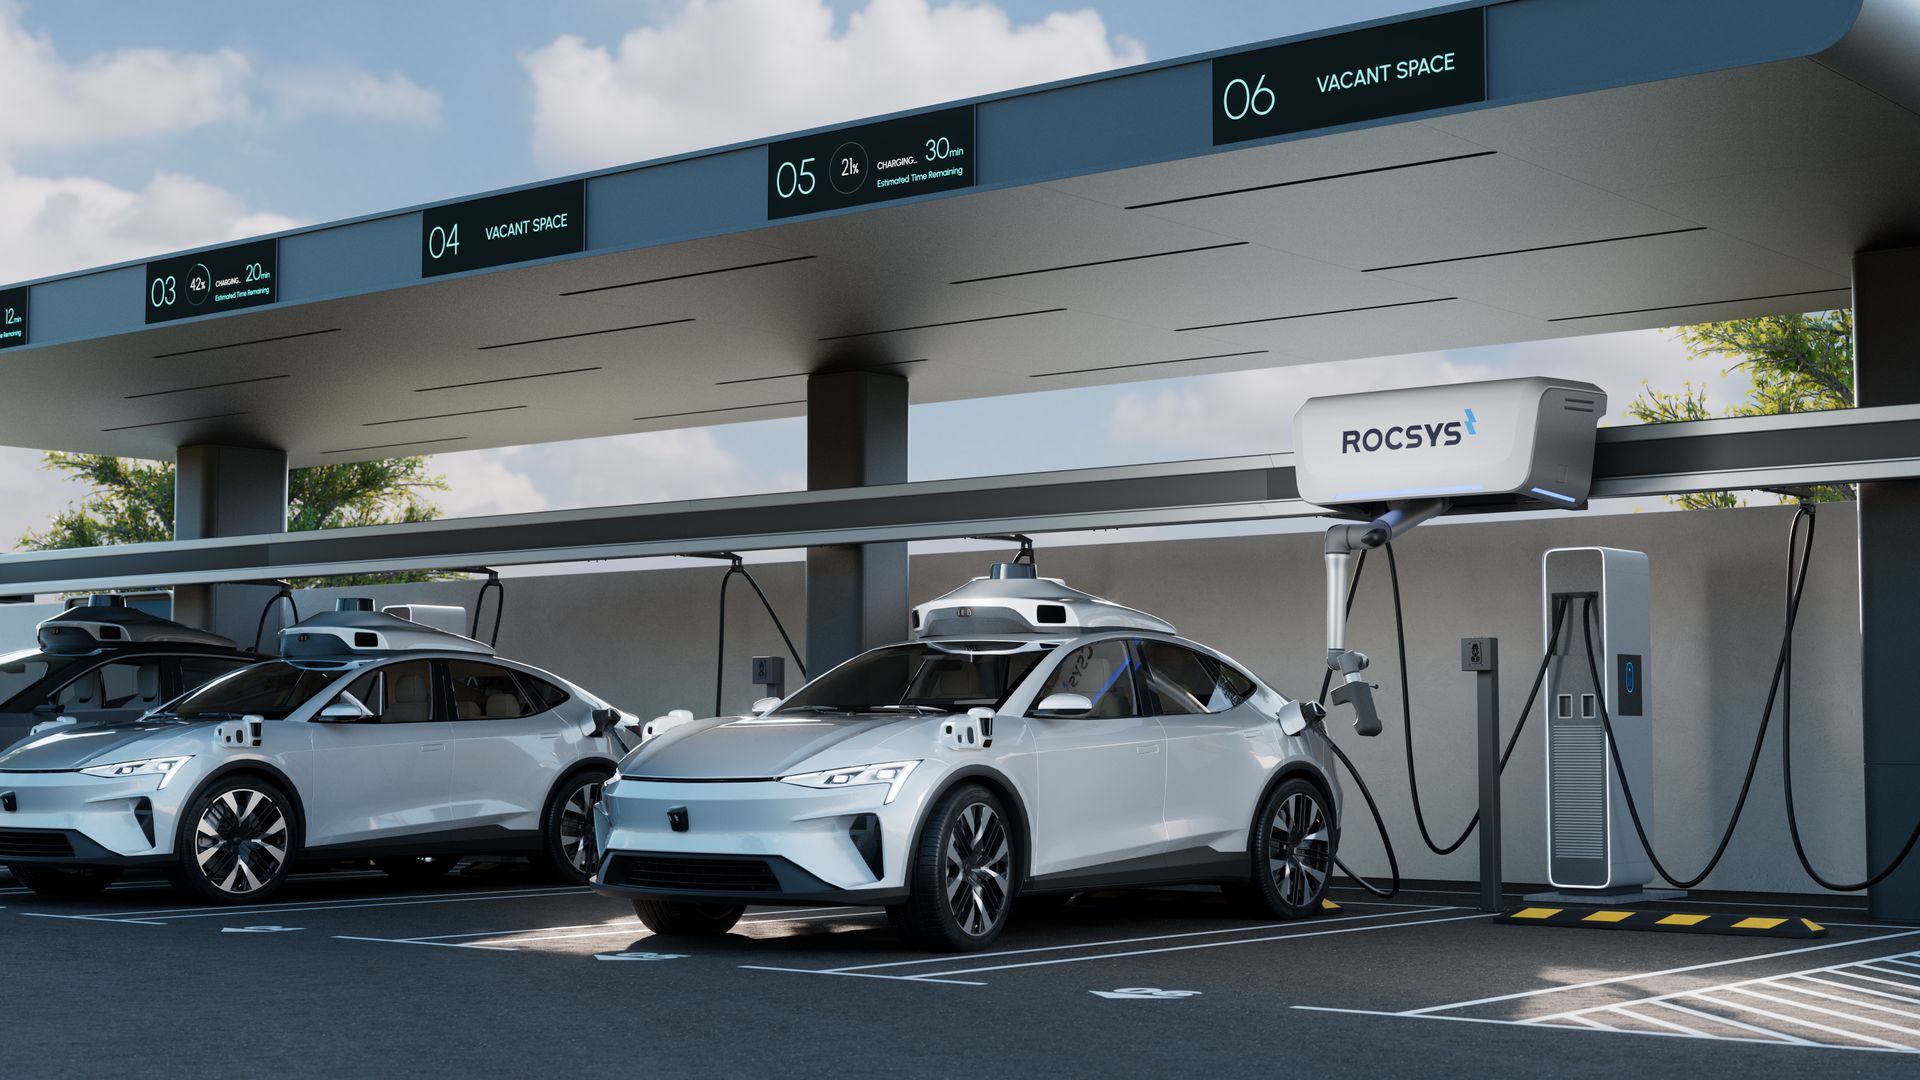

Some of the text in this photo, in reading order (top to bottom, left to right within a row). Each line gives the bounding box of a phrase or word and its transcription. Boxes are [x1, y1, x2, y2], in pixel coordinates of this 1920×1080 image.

[1316, 52, 1456, 93] VACANT SPACE
[1223, 74, 1276, 120] 06
[776, 157, 816, 198] 05
[841, 157, 859, 176] 21%
[877, 167, 963, 188] Estimated Time Remaining
[429, 223, 460, 259] 04
[485, 213, 568, 241] VACANT SPACE
[151, 275, 176, 307] 03
[215, 287, 270, 301] Estimated Time Remaining
[1341, 421, 1463, 454] ROCSYS
